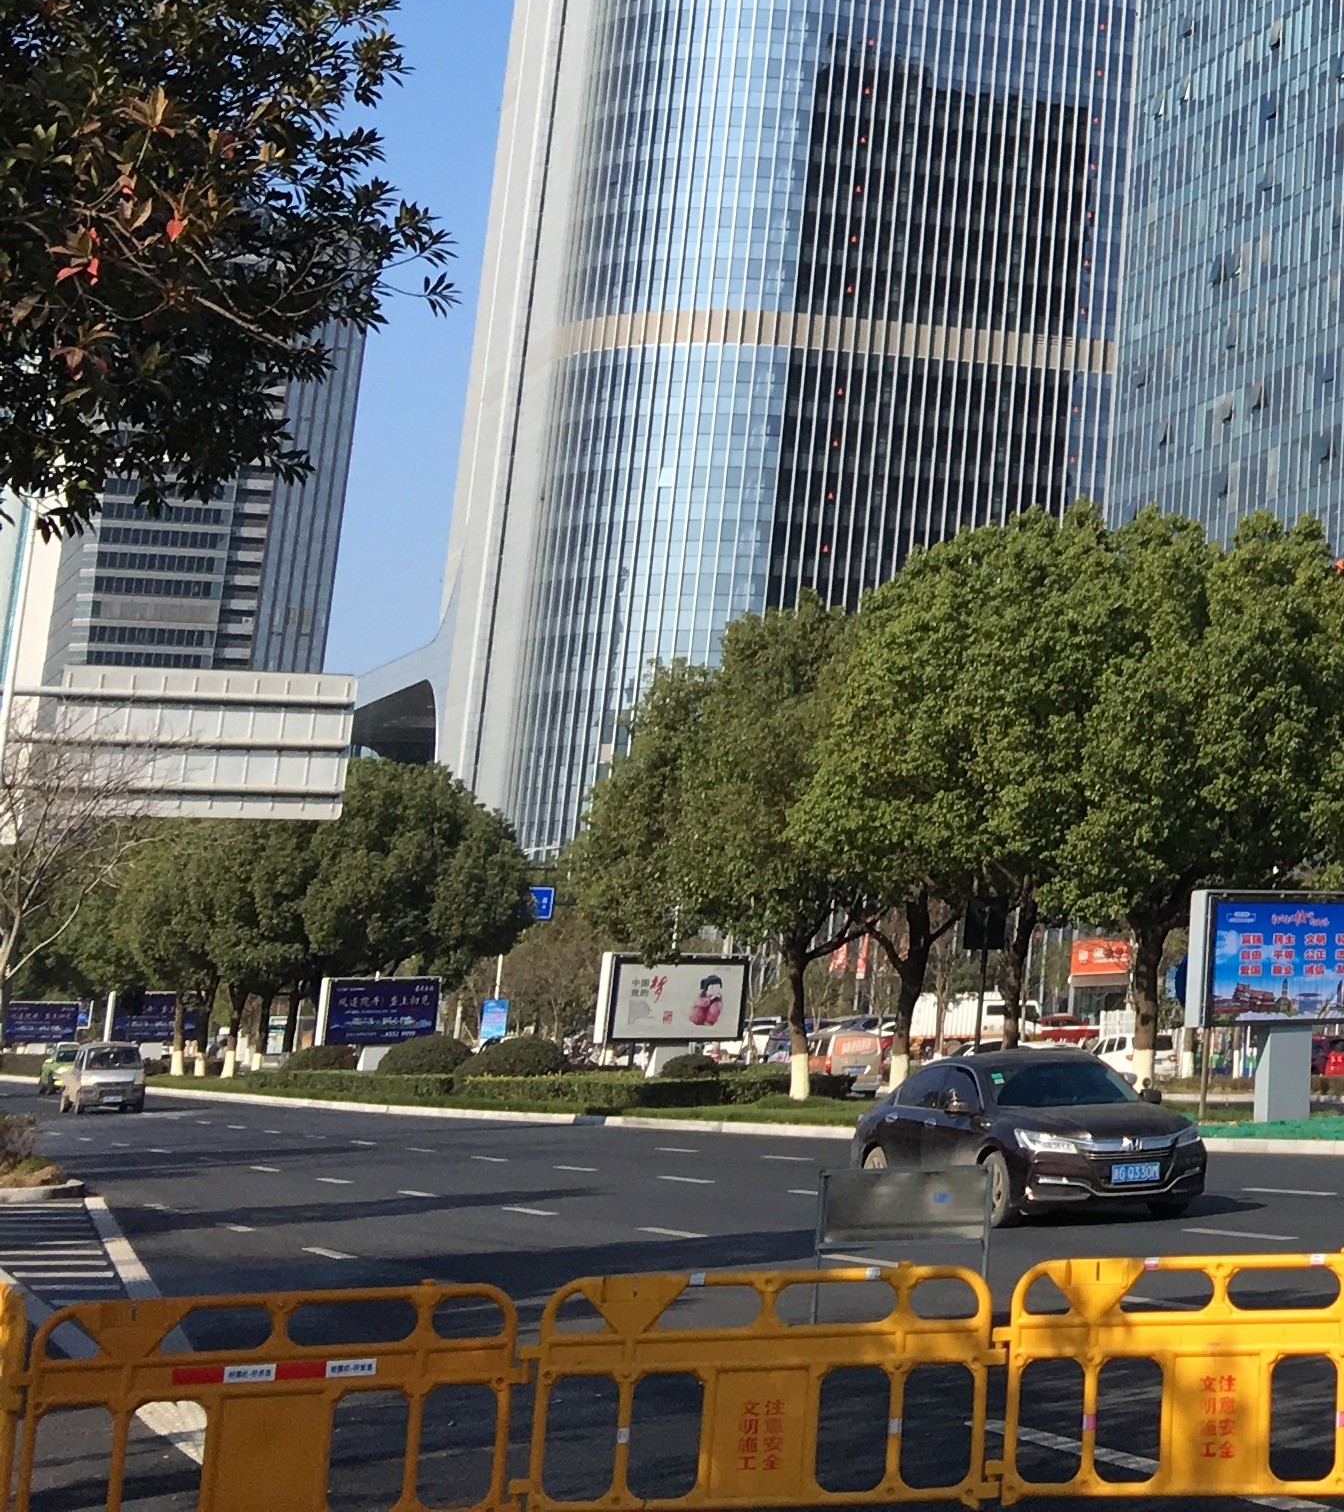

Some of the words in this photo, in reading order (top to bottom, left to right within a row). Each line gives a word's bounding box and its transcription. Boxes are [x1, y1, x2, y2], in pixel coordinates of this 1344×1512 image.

[738, 1400, 760, 1471] 文明施工
[762, 1399, 784, 1471] 注意安全
[1200, 1375, 1217, 1458] 文明施工
[1219, 1375, 1236, 1458] 注意安全
